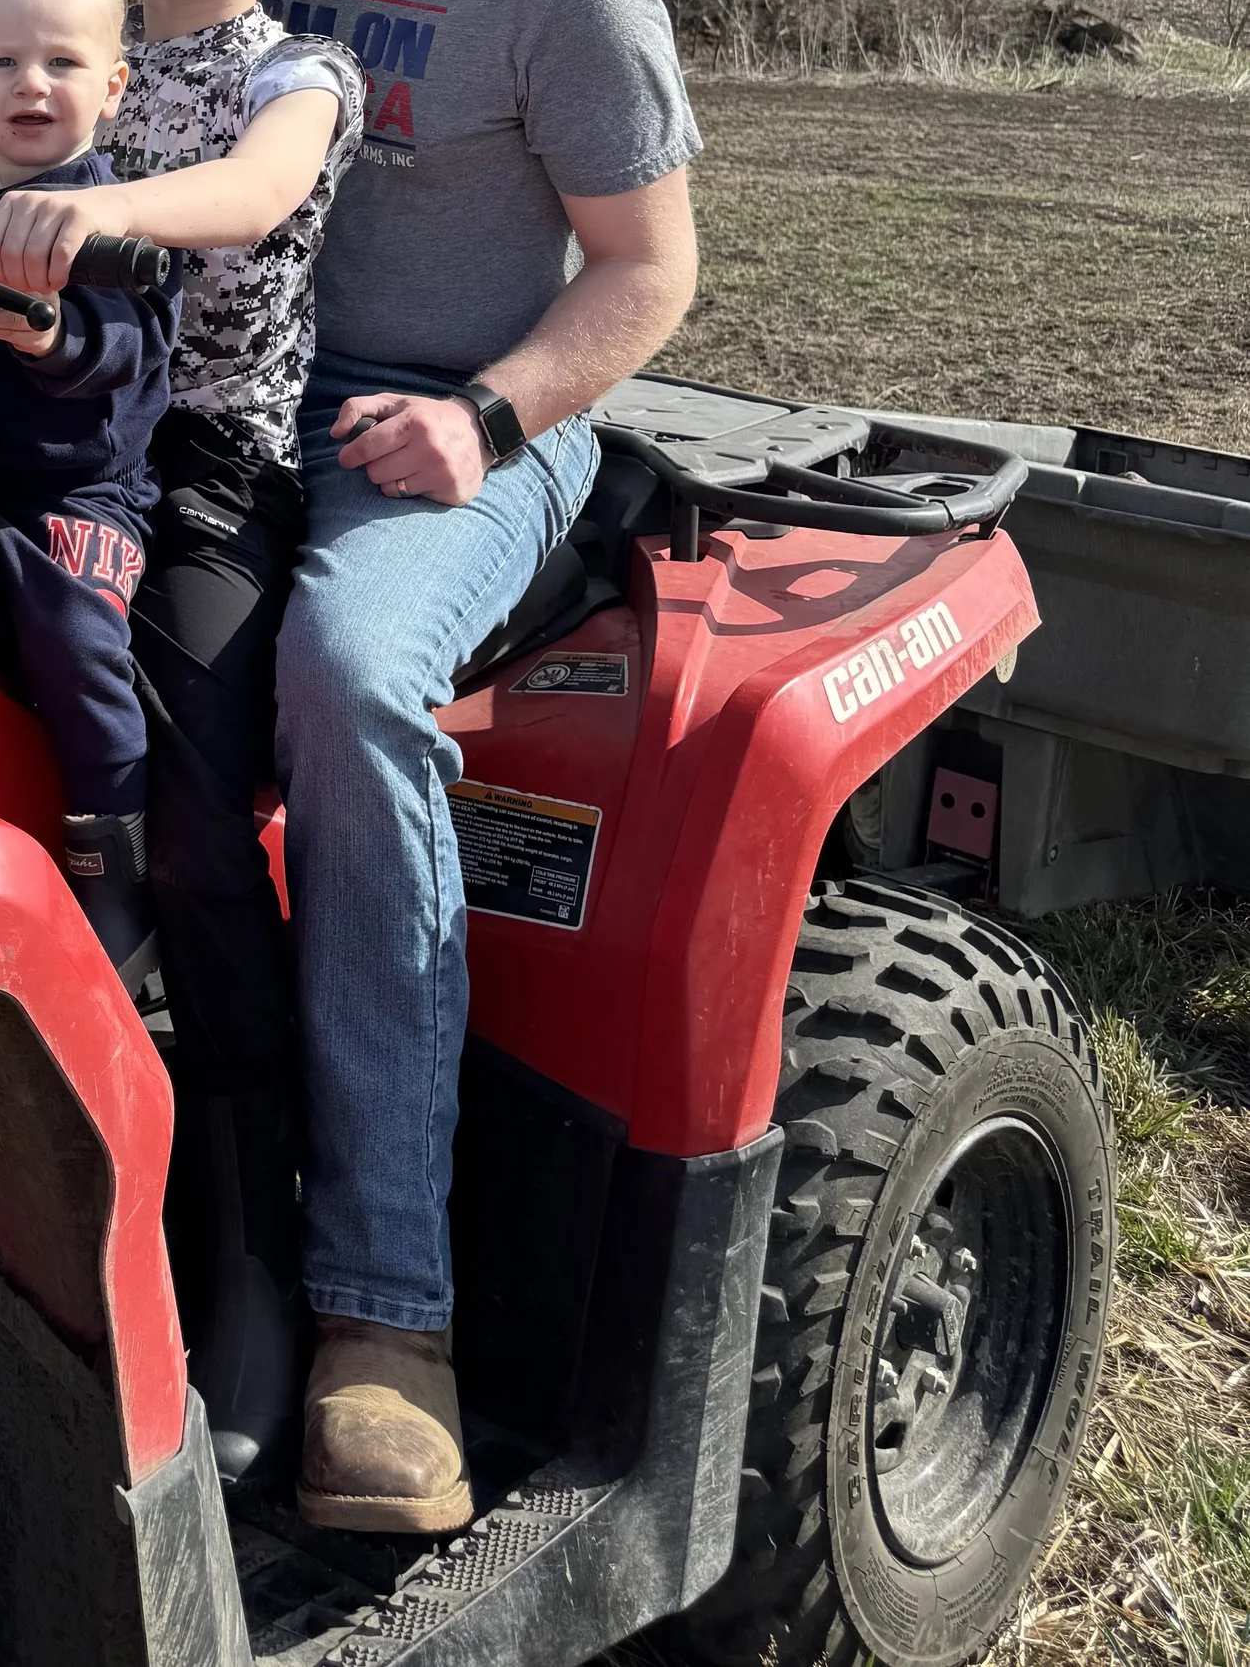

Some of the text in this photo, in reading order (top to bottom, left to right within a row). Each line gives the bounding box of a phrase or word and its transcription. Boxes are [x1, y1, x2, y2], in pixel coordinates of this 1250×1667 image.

[351, 11, 436, 79] ON
[392, 151, 415, 168] INC
[822, 601, 963, 724] can-am
[494, 794, 533, 809] WARNING
[848, 1205, 903, 1509] CARLISLE
[1049, 1177, 1104, 1498] TRAIL WOLF
